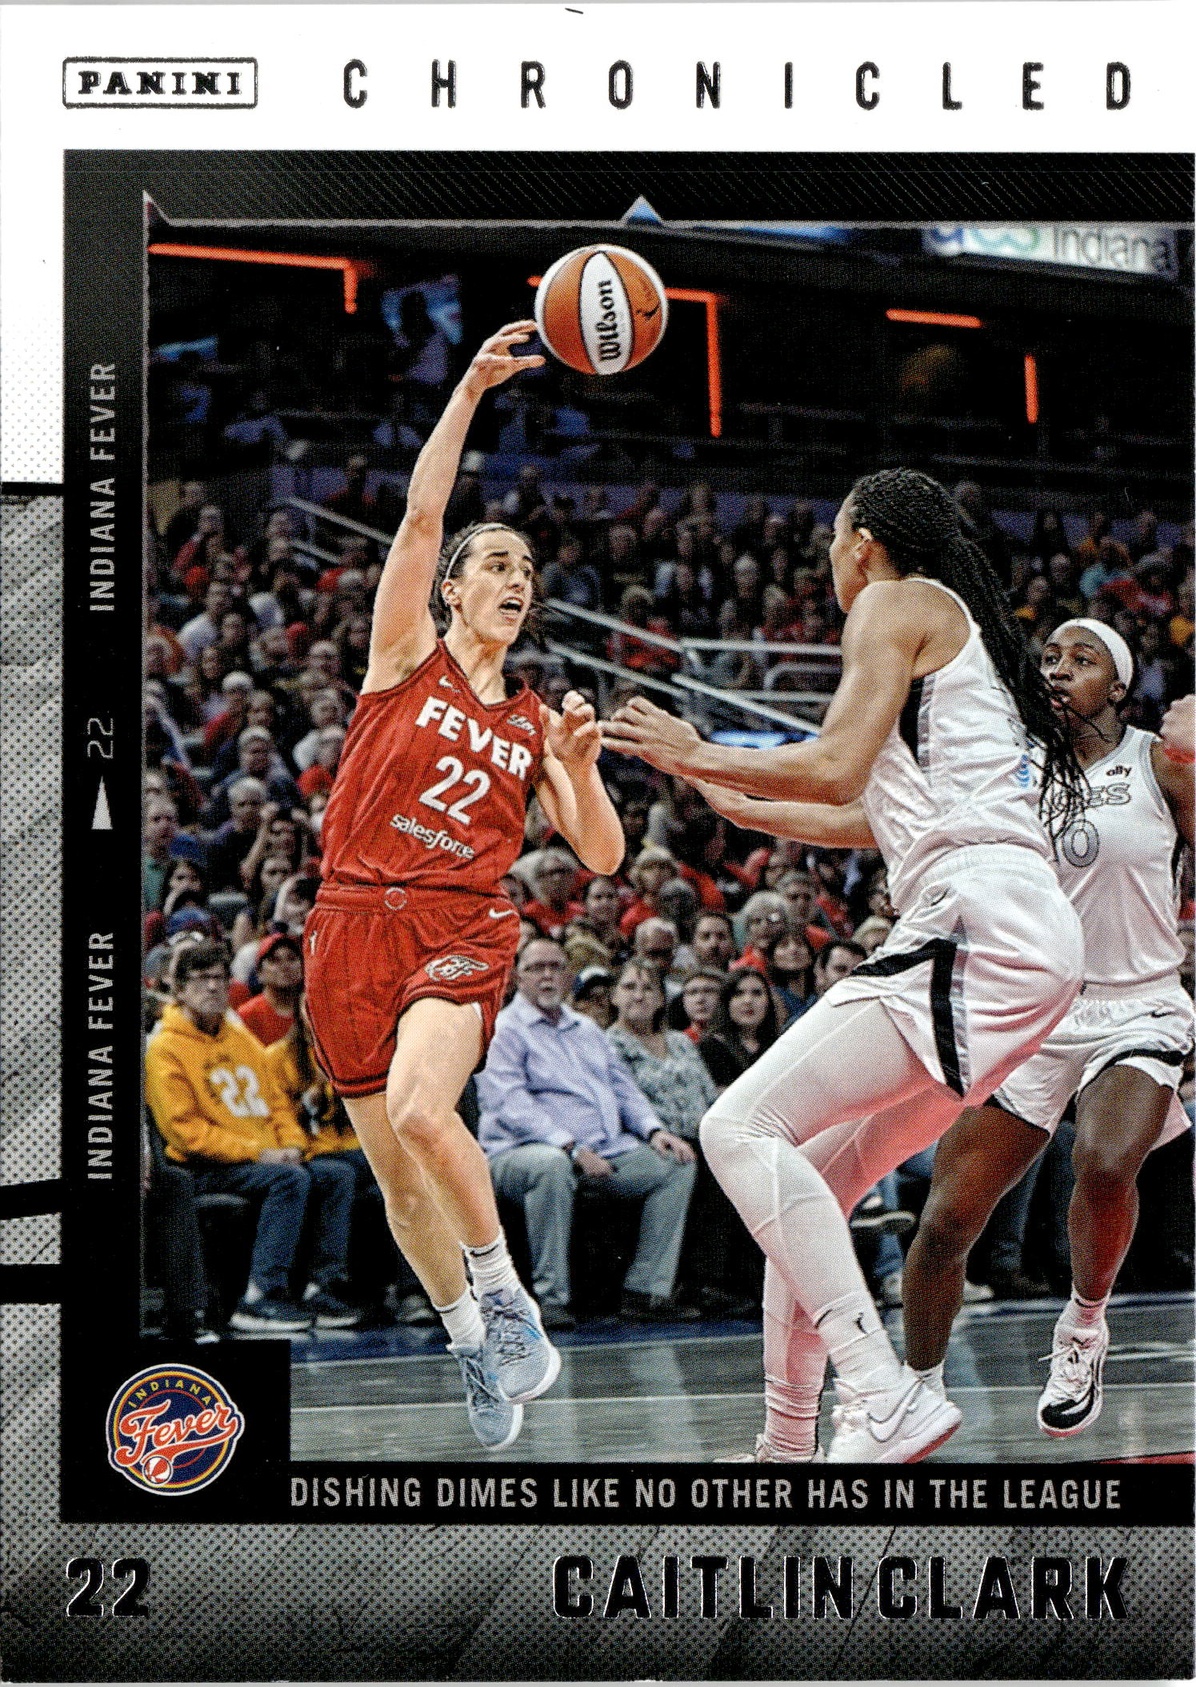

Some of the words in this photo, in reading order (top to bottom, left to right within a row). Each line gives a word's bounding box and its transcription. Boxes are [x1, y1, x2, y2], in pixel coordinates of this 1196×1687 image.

[78, 70, 242, 95] PANINI
[343, 59, 1132, 109] CHRONICLED
[595, 280, 622, 361] Wilson
[89, 362, 116, 461] FEVER
[89, 477, 116, 612] INDIANA
[87, 717, 114, 760] 22
[415, 696, 533, 781] FEVER
[418, 755, 491, 825] 22
[1106, 765, 1132, 777] ally
[390, 814, 475, 860] salesforce
[1062, 819, 1099, 868] 0
[88, 932, 114, 1030] FEVER
[88, 1045, 113, 1180] INDIANA
[210, 1065, 269, 1118] 22
[128, 1379, 212, 1408] INDIANA
[115, 1399, 239, 1466] Fever
[290, 1477, 421, 1508] DISHING
[437, 1477, 538, 1508] DIMES
[553, 1478, 620, 1508] LIKE
[635, 1479, 676, 1508] NO
[690, 1478, 792, 1509] OTHER
[808, 1479, 869, 1509] HAS
[884, 1479, 914, 1509] IN
[929, 1479, 988, 1509] THE
[1003, 1479, 1122, 1510] LEAGUE
[66, 1557, 149, 1617] 22
[552, 1555, 854, 1619] CAITLIN
[877, 1556, 1129, 1619] CLARK
